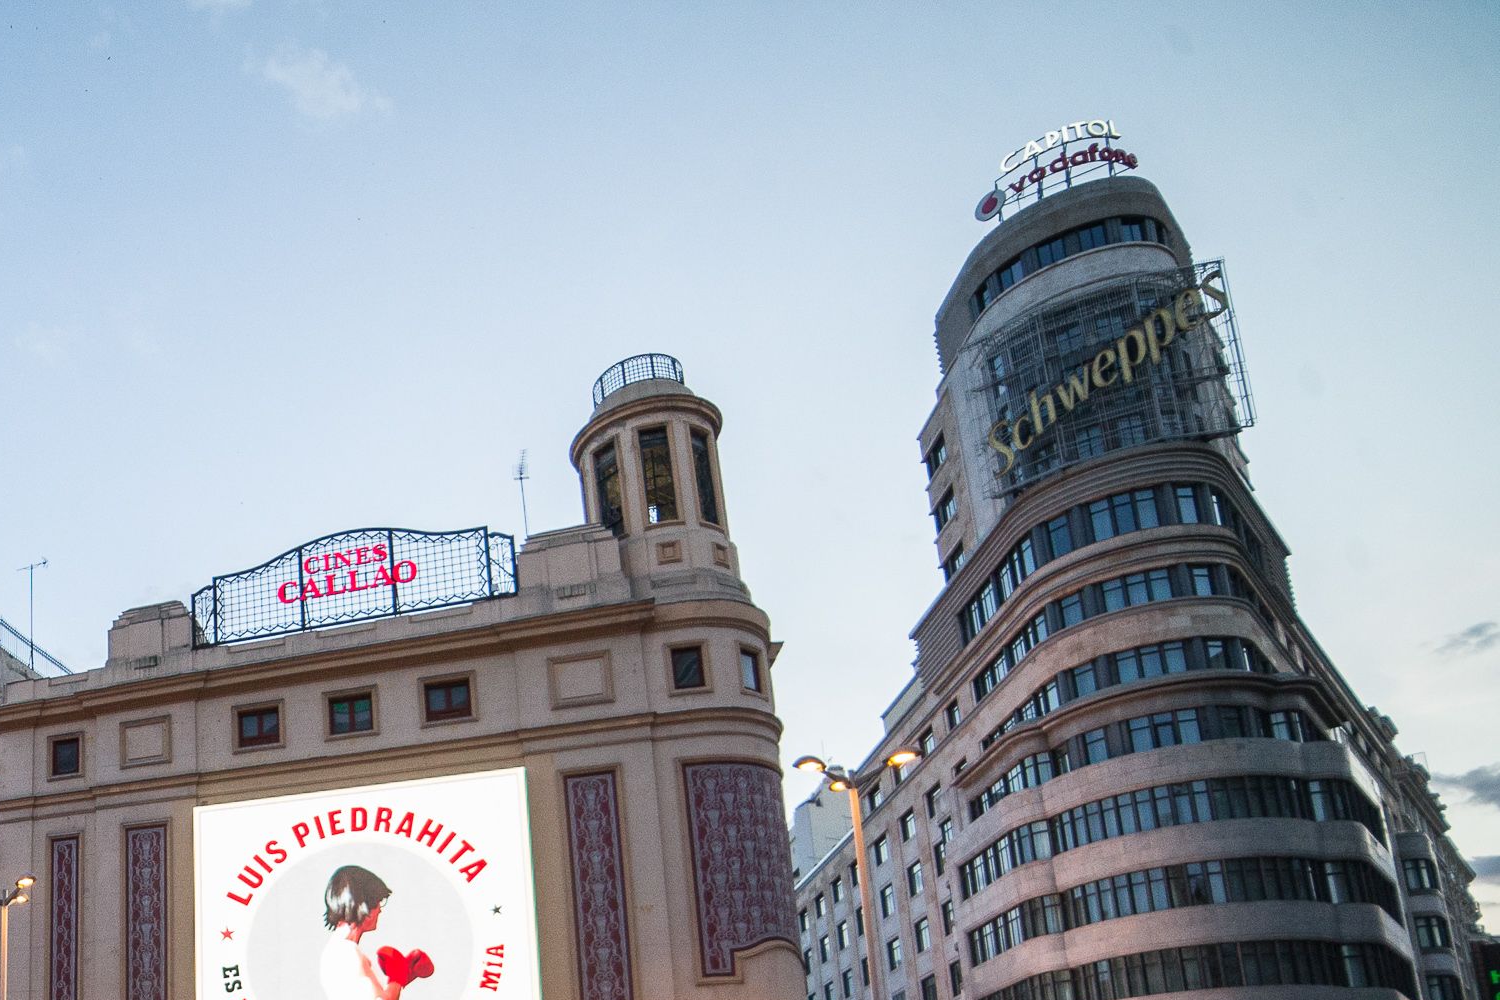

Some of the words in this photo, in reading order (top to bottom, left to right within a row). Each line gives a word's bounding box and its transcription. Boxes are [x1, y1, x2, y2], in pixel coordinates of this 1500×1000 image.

[1000, 119, 1121, 173] CAPITOL
[1008, 142, 1139, 194] vodafone
[987, 270, 1230, 478] Schweppes
[277, 560, 417, 604] CALLAO
[303, 543, 388, 574] CINES
[226, 839, 288, 906] LUIS
[291, 807, 488, 883] PIEDRAHITA
[222, 964, 242, 993] ES
